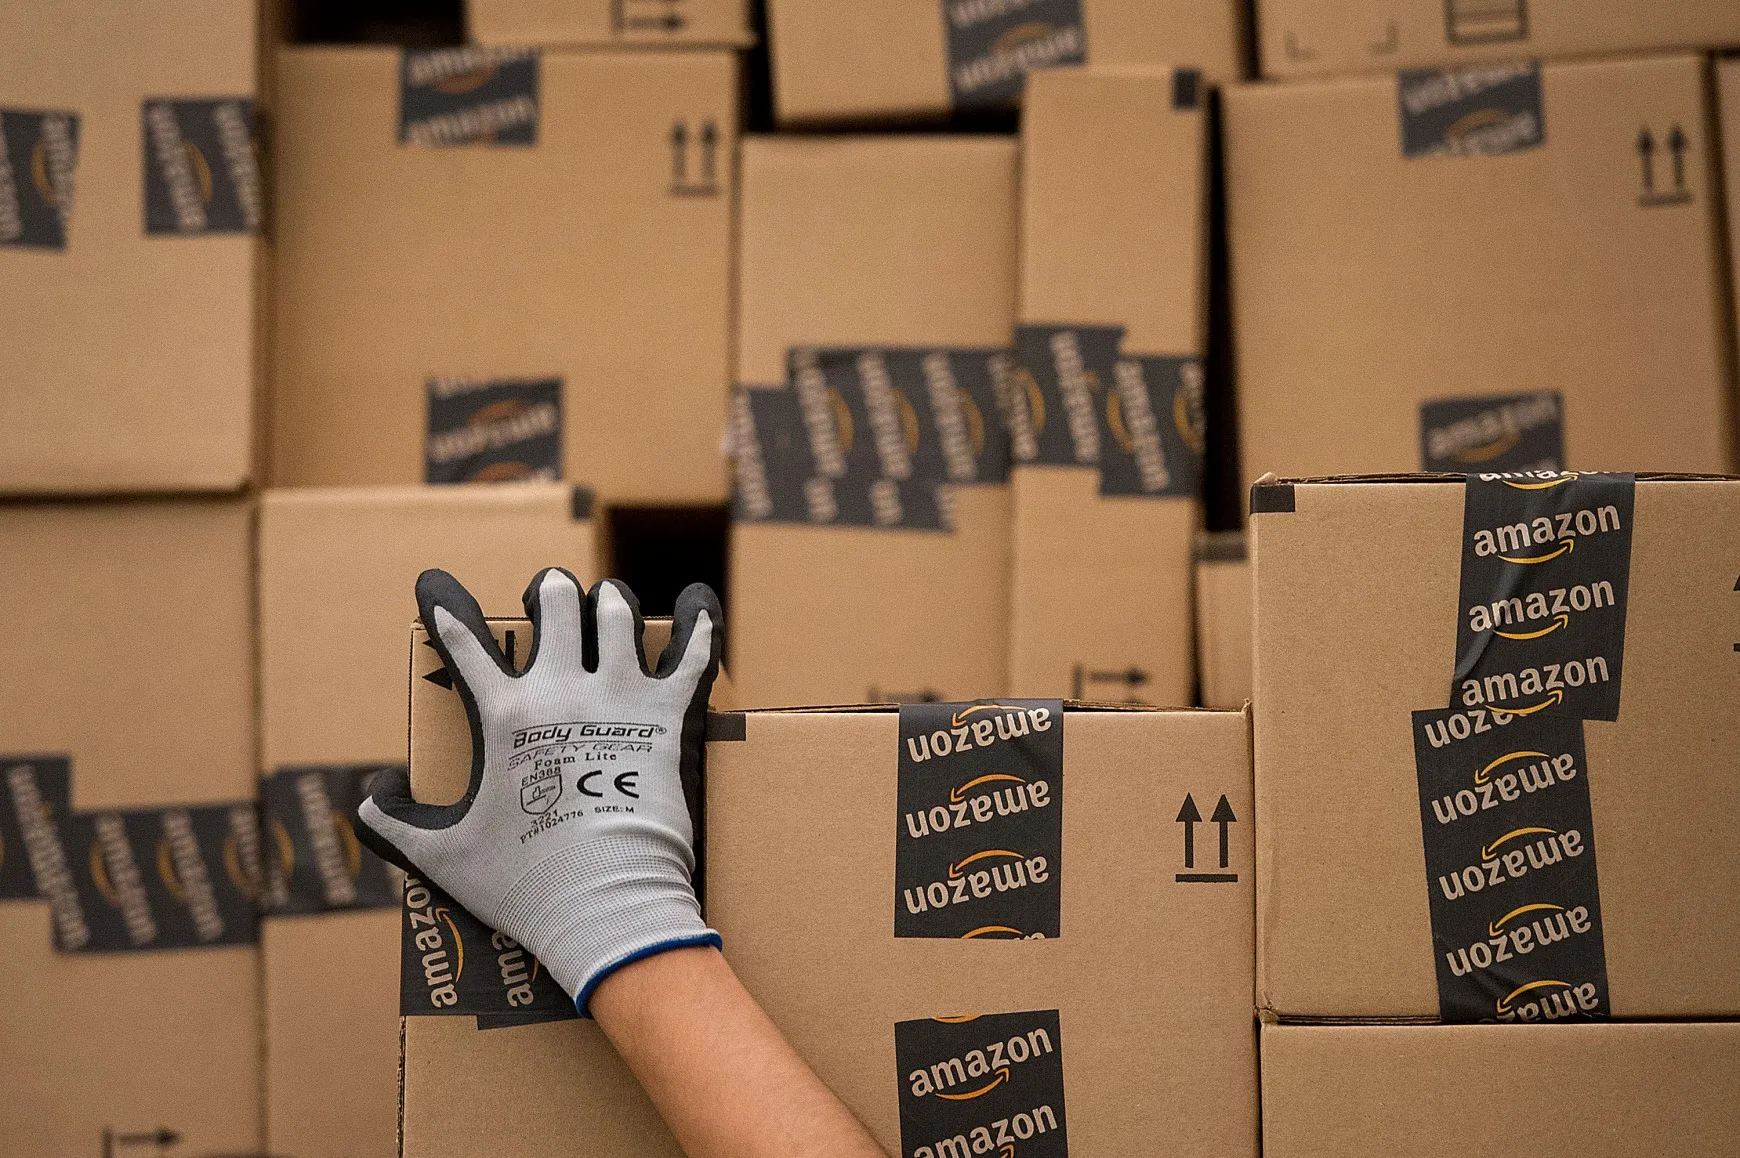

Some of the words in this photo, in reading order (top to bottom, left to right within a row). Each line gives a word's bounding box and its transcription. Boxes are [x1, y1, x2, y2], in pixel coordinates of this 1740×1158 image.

[1474, 505, 1620, 557] amazon
[1469, 580, 1615, 633] amazon
[1461, 656, 1609, 706] amazon
[507, 744, 585, 771] SAFETY
[592, 743, 653, 753] GEAR
[513, 726, 572, 749] Body
[534, 756, 576, 770] Foam
[585, 752, 617, 761] Lite
[907, 707, 1051, 763] amazon
[521, 766, 562, 787] EN388
[1432, 753, 1577, 825] amazon
[906, 780, 1050, 838] amazon
[904, 856, 1049, 914] amazon
[1439, 829, 1584, 900] amazon
[1446, 906, 1592, 977] amazon
[909, 1028, 1053, 1097] amazon
